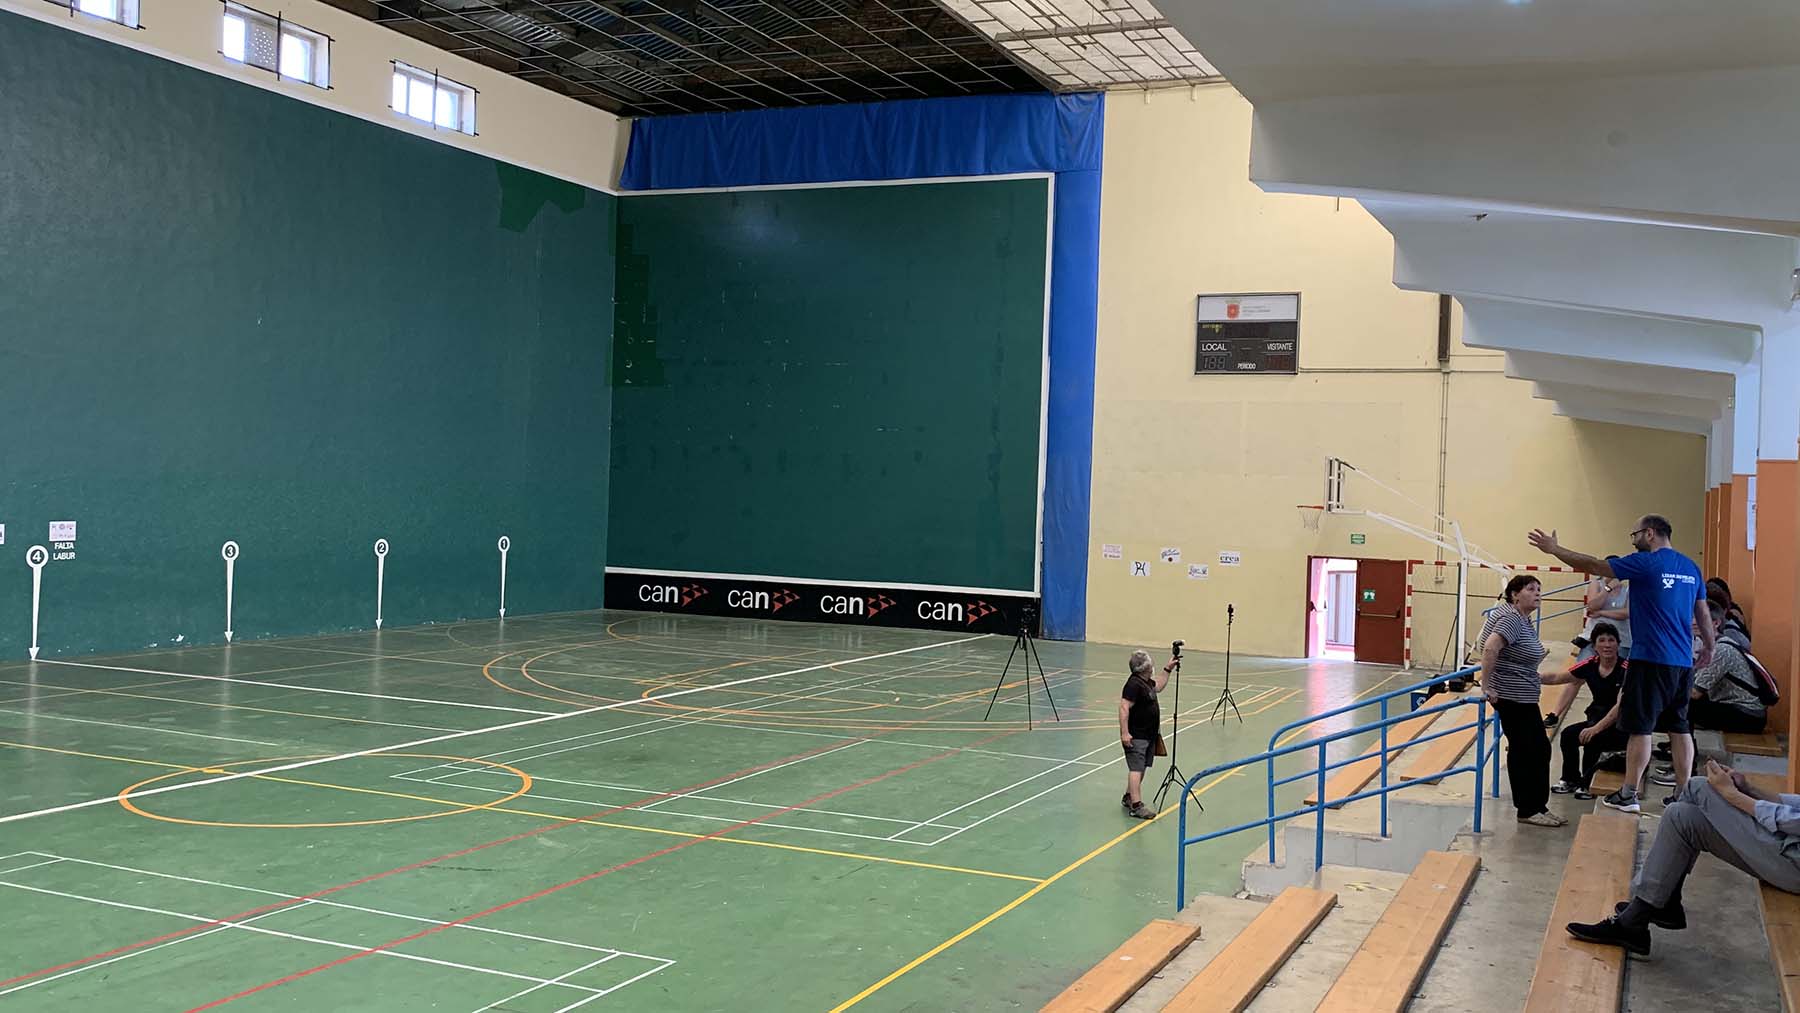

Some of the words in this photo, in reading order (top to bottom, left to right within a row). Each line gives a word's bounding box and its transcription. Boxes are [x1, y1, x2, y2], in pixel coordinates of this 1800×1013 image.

[1202, 343, 1227, 351] LOCAL
[1266, 342, 1293, 351] VISITANTE
[54, 542, 74, 550] FALTA
[227, 546, 234, 557] 3
[32, 551, 42, 562] 4
[53, 552, 76, 560] LABUR
[639, 584, 679, 604] can
[727, 589, 769, 609] can
[820, 595, 864, 615] can
[917, 600, 963, 622] can
